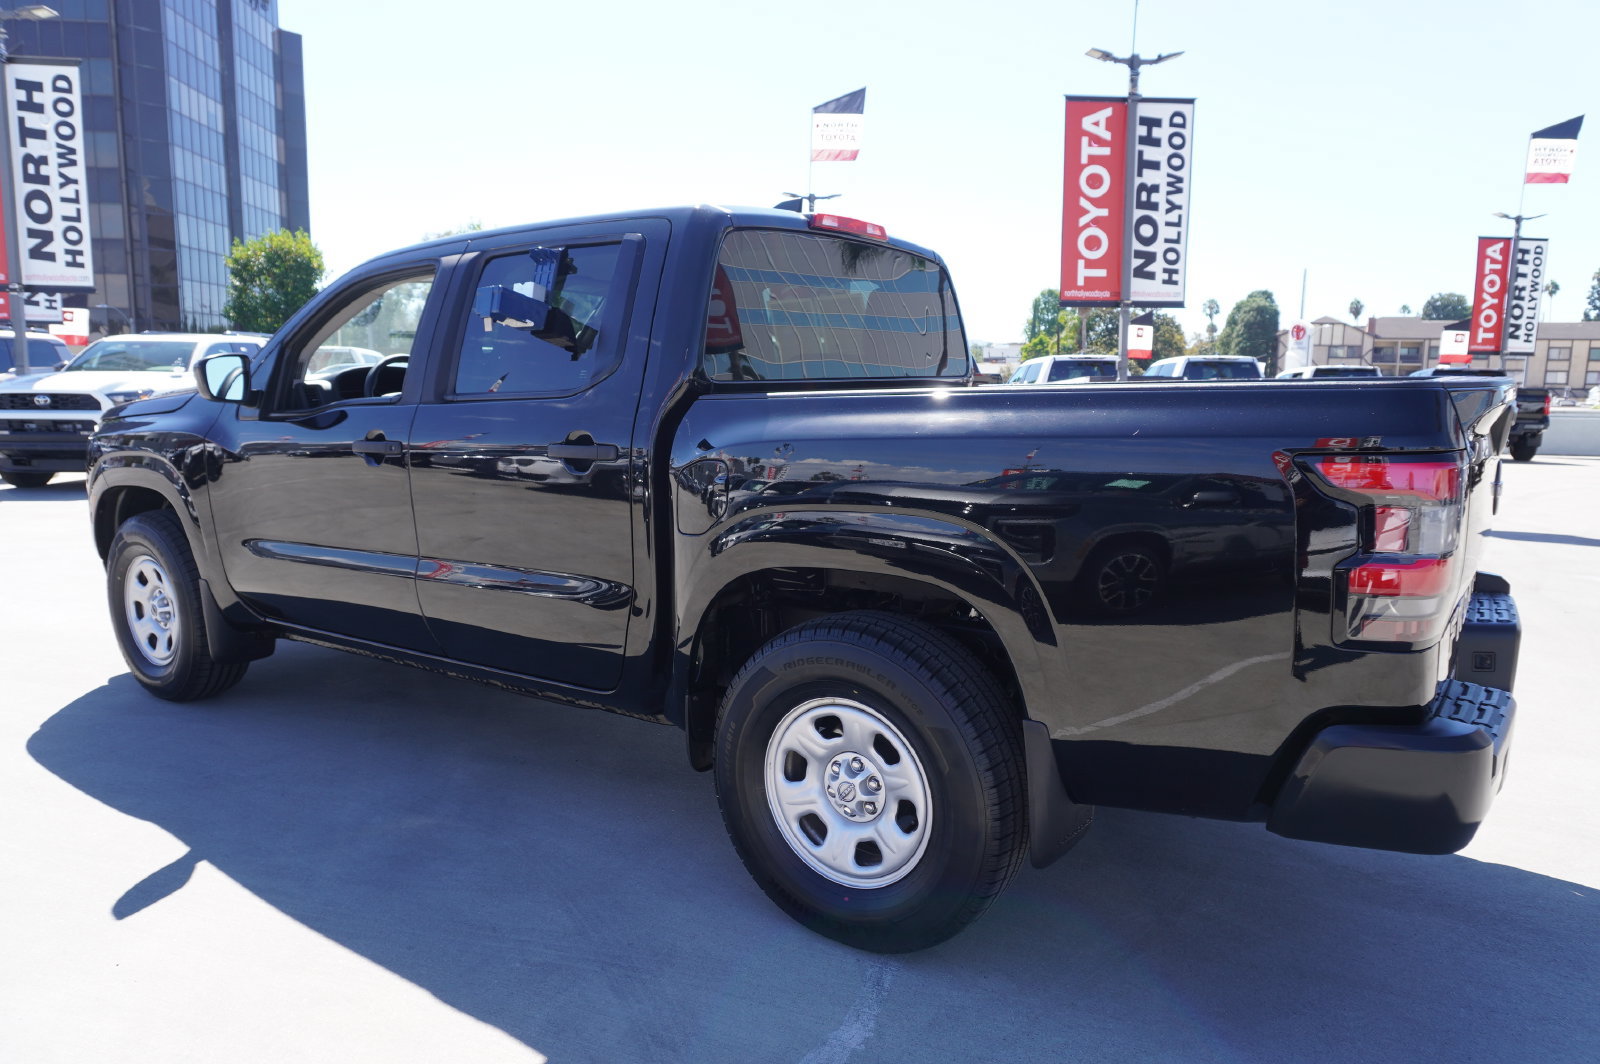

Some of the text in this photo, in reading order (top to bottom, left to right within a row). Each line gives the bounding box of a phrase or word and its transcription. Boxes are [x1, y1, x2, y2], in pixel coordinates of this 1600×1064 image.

[15, 78, 57, 263] NORTH
[51, 74, 86, 269] HOLLYWOOD
[1076, 106, 1113, 286] TOYOTA
[1132, 115, 1163, 281] NORTH
[1161, 110, 1187, 286] HOLLYWOOD
[1477, 241, 1505, 343] TOYOTA
[1508, 248, 1531, 340] NORTH
[1523, 245, 1544, 343] HOLLYWOOD
[783, 656, 897, 690] RIDGECRAWLER
